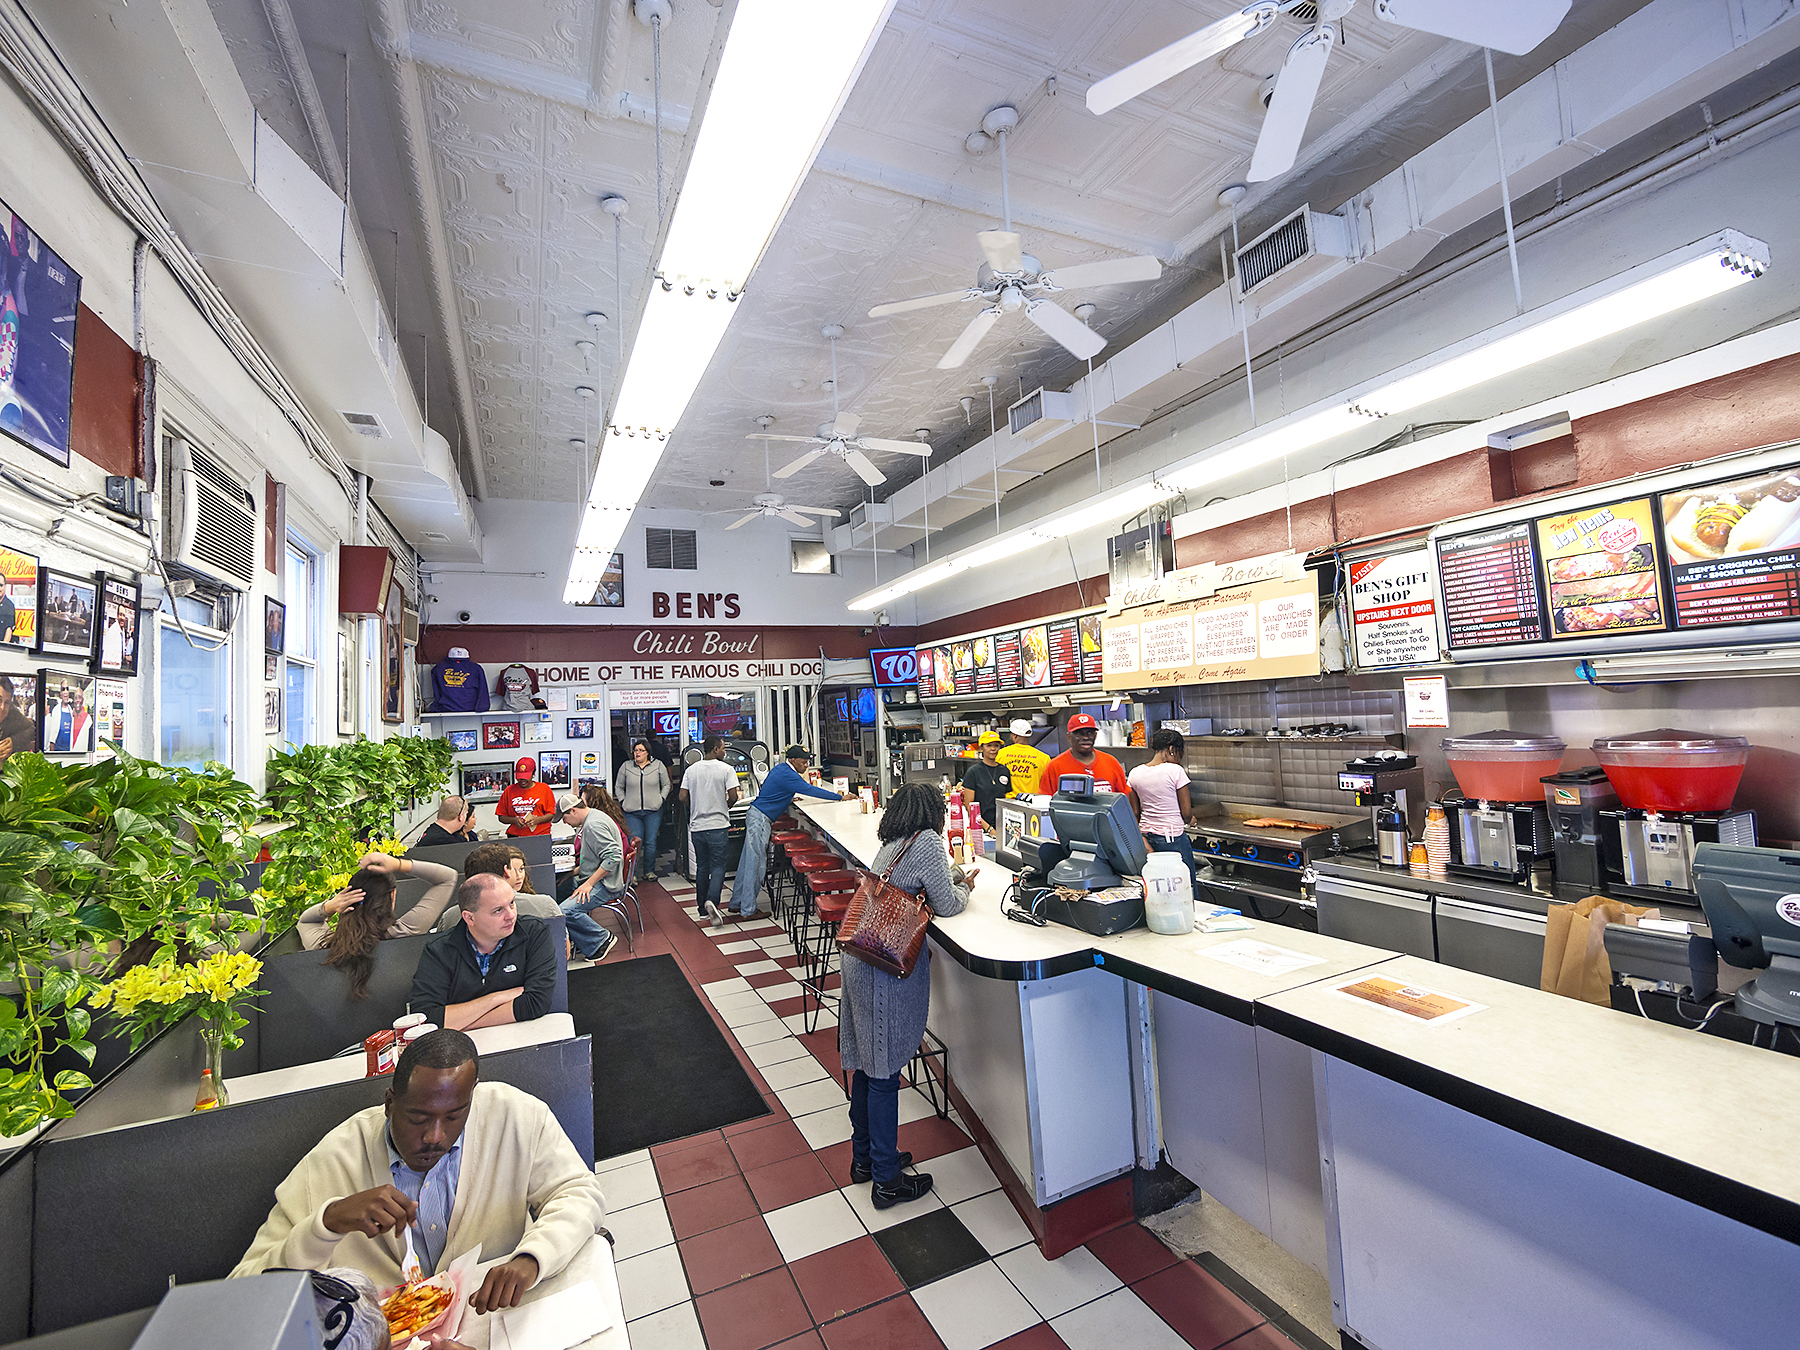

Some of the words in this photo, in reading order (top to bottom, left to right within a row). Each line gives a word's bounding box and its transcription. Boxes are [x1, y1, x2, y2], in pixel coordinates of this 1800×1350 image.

[1548, 527, 1579, 551] New
[1574, 508, 1615, 537] Items
[1549, 522, 1565, 531] Try
[1567, 515, 1579, 524] the
[1441, 542, 1464, 552] BEN'S
[1353, 561, 1374, 581] VISIT
[1593, 567, 1624, 578] Salad
[1626, 562, 1655, 573] Bowl
[1687, 564, 1717, 575] BEN'S
[1717, 558, 1767, 570] ORIGINAL
[1767, 554, 1796, 564] CHILI
[1677, 573, 1703, 583] HALF
[1708, 568, 1745, 579] SMOKE
[1355, 578, 1393, 594] BEN'S
[1396, 571, 1429, 587] GIFT
[1691, 582, 1706, 590] BILL
[1706, 579, 1733, 589] COSBY'S
[1123, 584, 1161, 606] Chili
[1372, 590, 1411, 605] SHOP
[1585, 594, 1622, 606] Gourmet
[1625, 591, 1656, 600] Burger
[652, 592, 741, 619] BEN'S
[1155, 602, 1190, 617] Appreciate
[1193, 599, 1211, 611] Your
[1213, 590, 1253, 606] Patronage
[1277, 602, 1294, 612] OUR
[1689, 599, 1708, 608] BEN'S
[1708, 596, 1740, 606] ORIGINAL
[1262, 608, 1313, 624] SANDWICHES
[1356, 609, 1389, 622] UPSTAIRS
[1390, 606, 1410, 617] NEXT
[1410, 603, 1432, 615] DOOR
[1680, 608, 1708, 617] ORIGINALLY
[1722, 604, 1743, 612] FAMOUS
[1198, 616, 1214, 625] FOOD
[1216, 613, 1228, 621] AND
[1230, 610, 1249, 619] DRINK
[1608, 620, 1631, 628] Rice
[1634, 617, 1660, 626] Bowl
[1155, 620, 1188, 632] SANDWICHES
[1206, 620, 1244, 631] PURCHASED
[1265, 624, 1280, 632] ARE
[1286, 619, 1309, 629] MADE
[1150, 631, 1175, 641] WRAPPED
[1207, 629, 1243, 640] ELSEWHERE
[1281, 629, 1308, 640] ORDER
[1382, 629, 1409, 638] Smokes
[1410, 627, 1423, 635] and
[633, 629, 695, 655] Chili
[701, 630, 760, 656] Bowl
[1111, 637, 1139, 646] PERMITTED
[1197, 641, 1211, 650] MUST
[1213, 640, 1226, 648] NOT
[1236, 636, 1256, 645] EATEN
[1385, 638, 1407, 646] Frozen
[1409, 636, 1417, 644] To
[1419, 635, 1430, 643] Go
[1157, 645, 1184, 655] PRESERVE
[1197, 651, 1205, 659] ON
[1206, 649, 1224, 658] THESE
[1225, 644, 1256, 655] PREMISES
[1376, 647, 1392, 656] Ship
[1393, 644, 1427, 654] anywhere
[1114, 653, 1130, 661] GOOD
[1158, 655, 1169, 663] AND
[1170, 653, 1190, 662] FLAVOR
[1398, 653, 1416, 662] USA!
[1111, 660, 1132, 669] SERVICE
[536, 666, 590, 683] HOME
[598, 665, 622, 681] OF
[630, 665, 664, 680] THE
[671, 663, 740, 679] FAMOUS
[746, 662, 784, 677] CHILI
[790, 661, 822, 676] DOG
[1150, 671, 1170, 683] Thank
[1198, 667, 1219, 680] Come
[1221, 665, 1247, 679] Again
[1011, 764, 1030, 774] DCA
[1150, 876, 1183, 893] TIP
